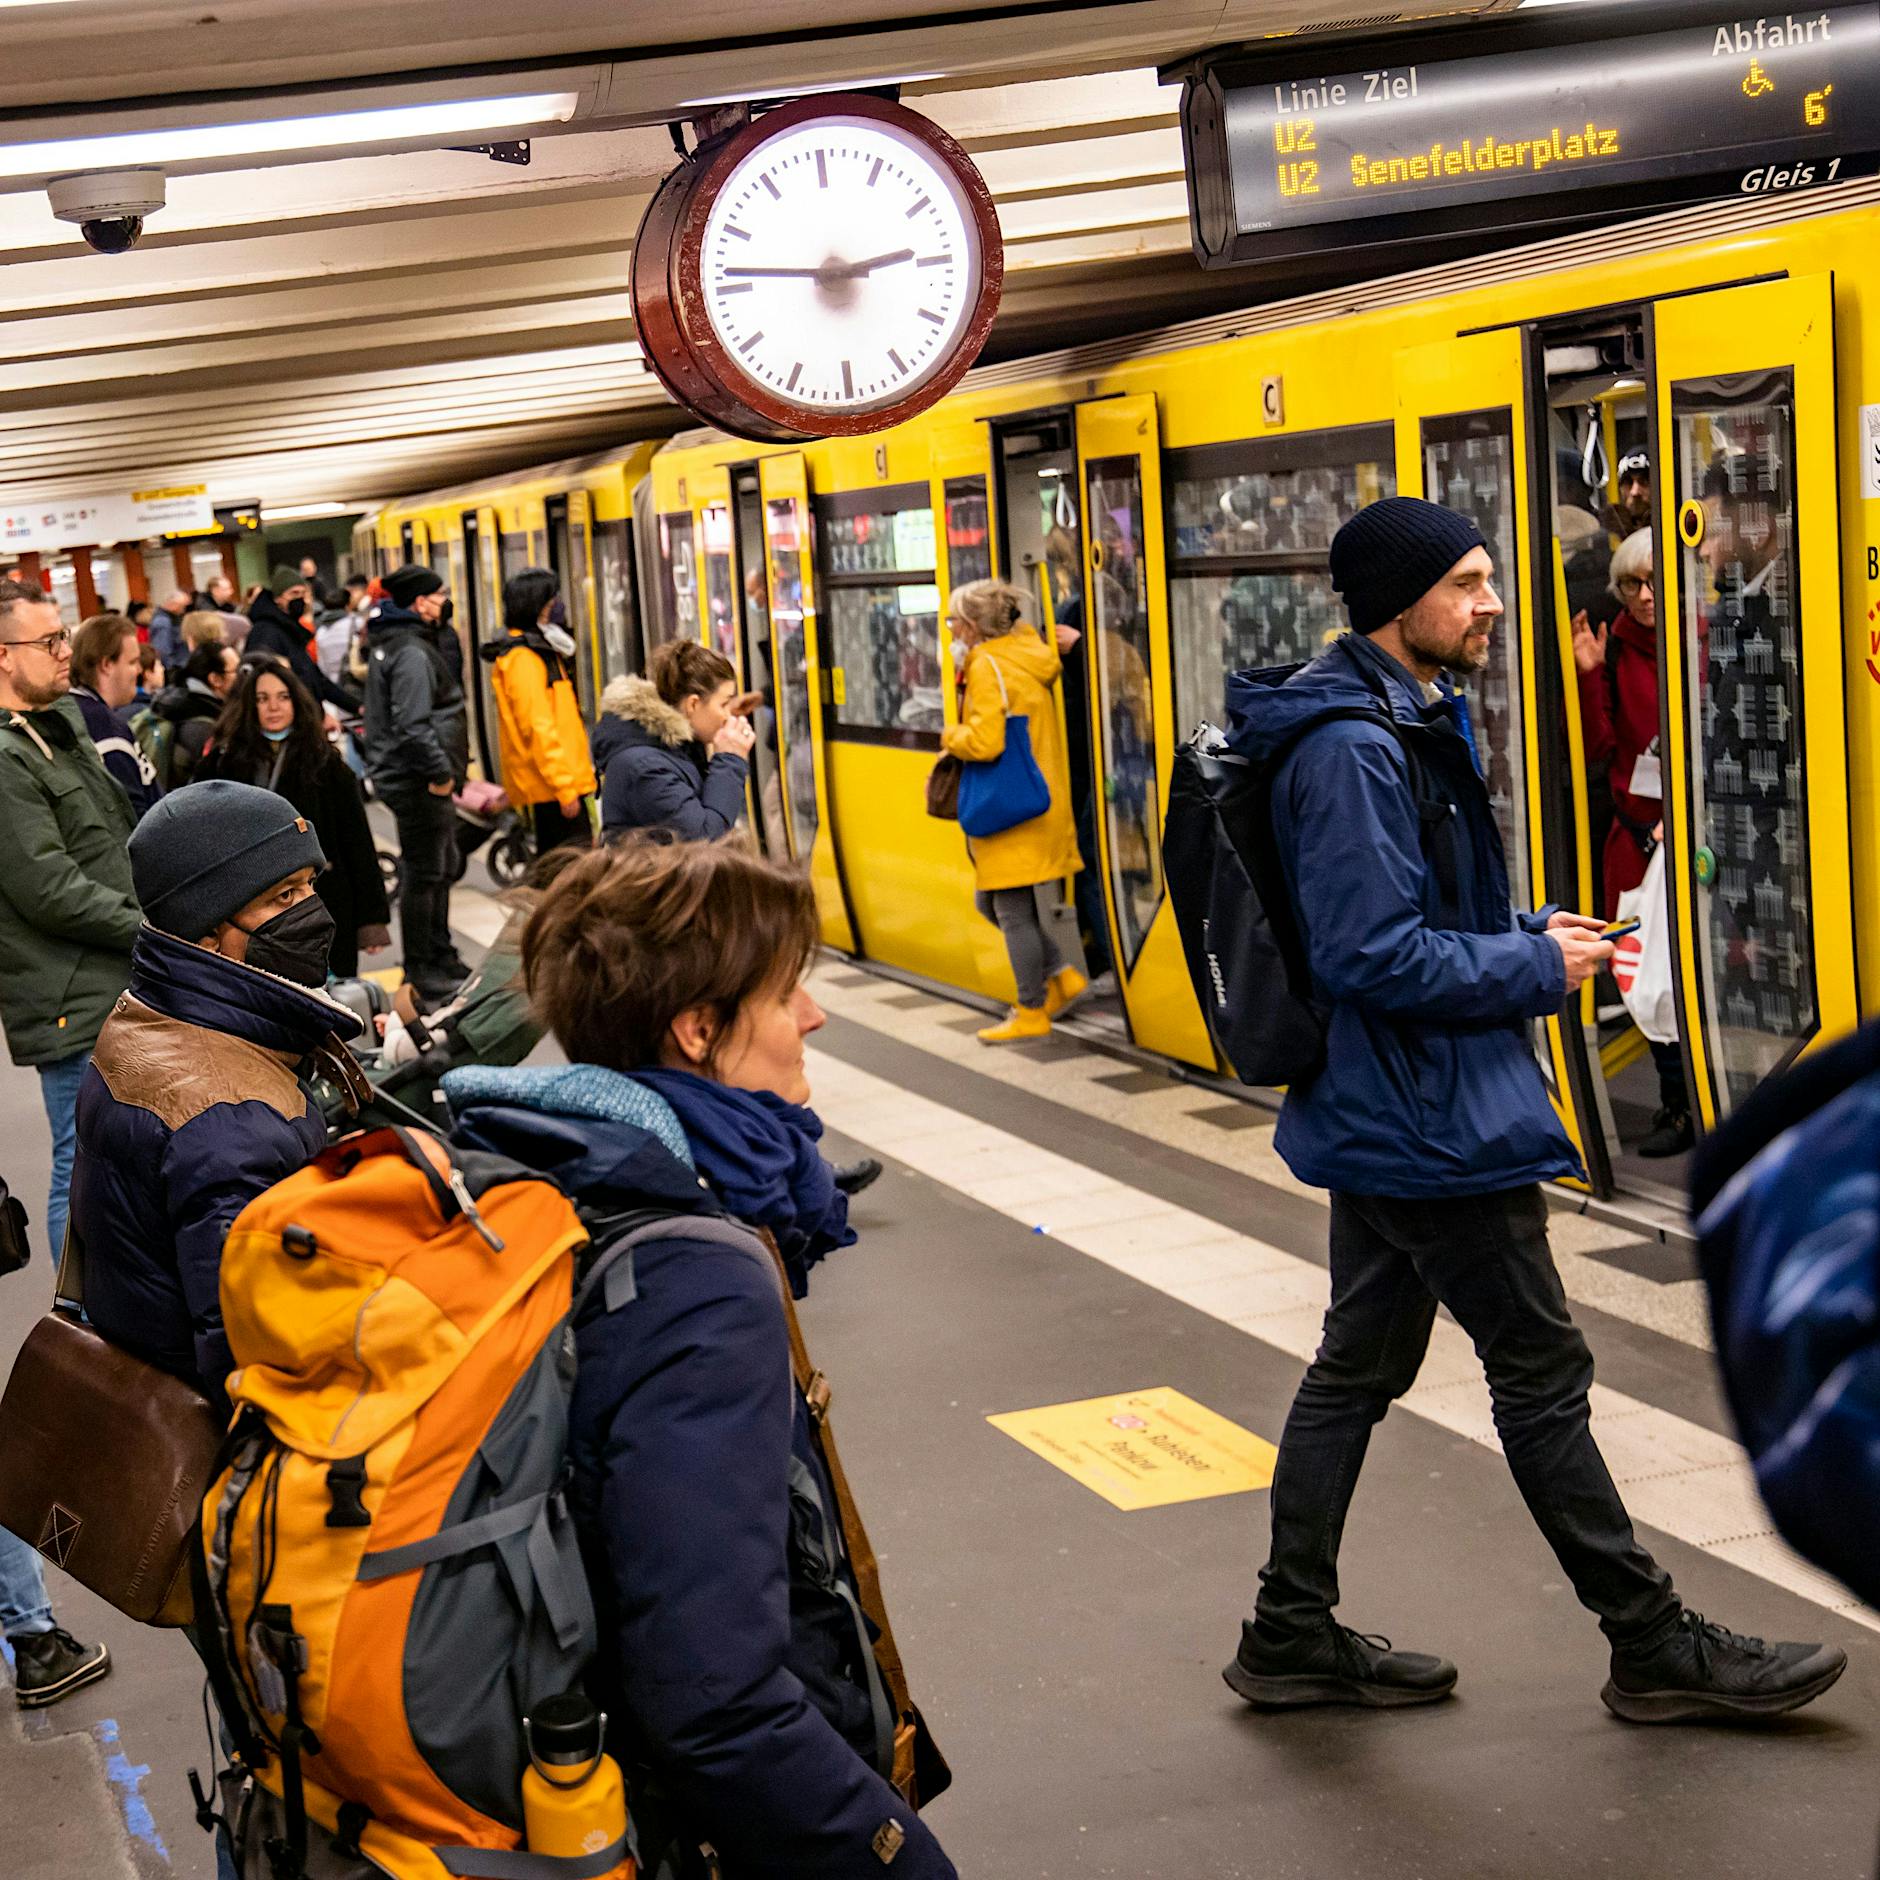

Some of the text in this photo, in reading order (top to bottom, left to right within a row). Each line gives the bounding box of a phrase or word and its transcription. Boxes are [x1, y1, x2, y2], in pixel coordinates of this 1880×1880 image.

[1712, 14, 1832, 57] Abfahrt
[1274, 66, 1418, 114] Linie Ziel
[1274, 118, 1317, 154] U2
[1277, 123, 1619, 196] U2 Senefelderplatz
[1740, 157, 1841, 193] Gleis 1
[1241, 221, 1272, 231] SIEMENS
